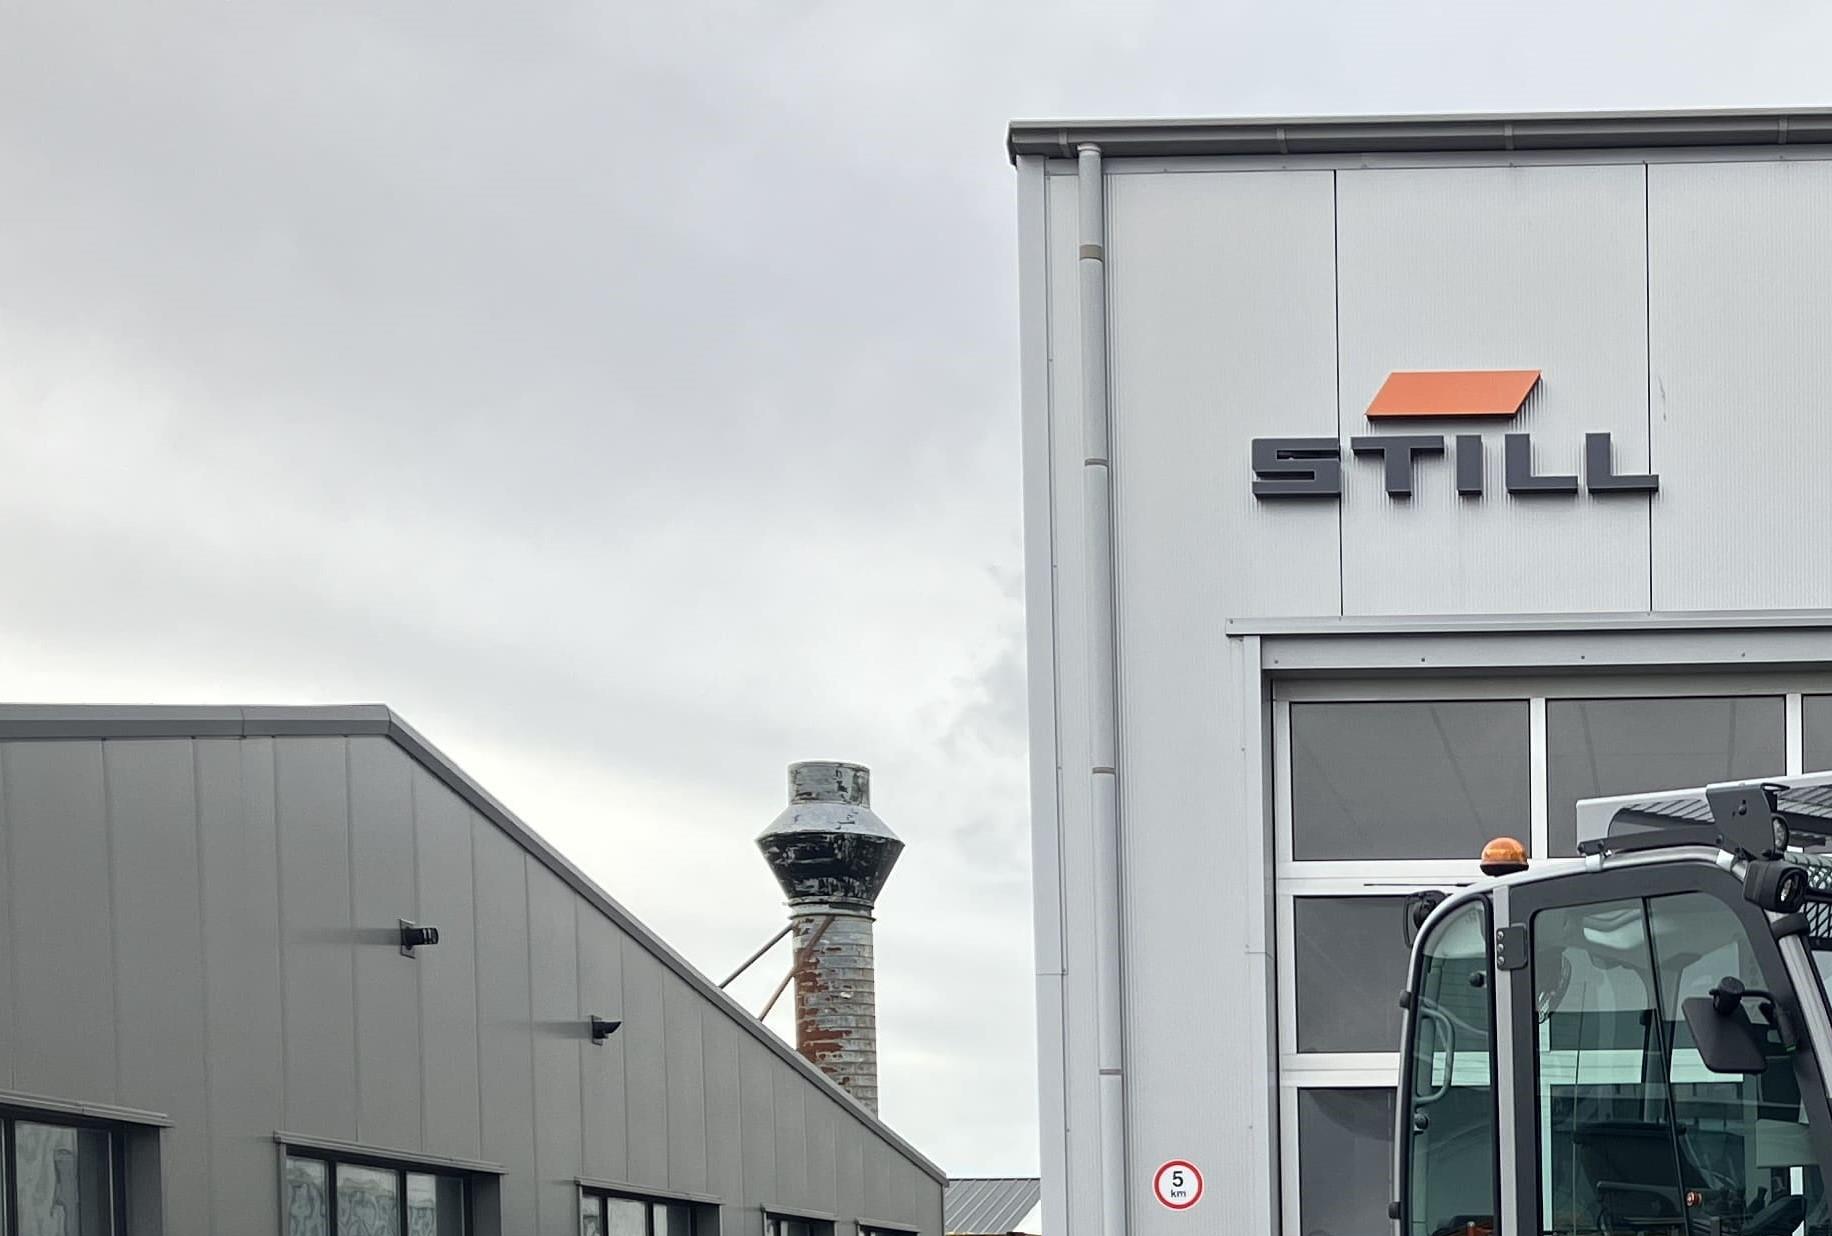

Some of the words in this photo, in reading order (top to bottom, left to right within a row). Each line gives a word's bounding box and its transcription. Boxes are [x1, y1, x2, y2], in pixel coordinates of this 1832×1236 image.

[1252, 432, 1659, 499] STILL
[1172, 1170, 1184, 1188] 5
[1170, 1189, 1186, 1198] km
